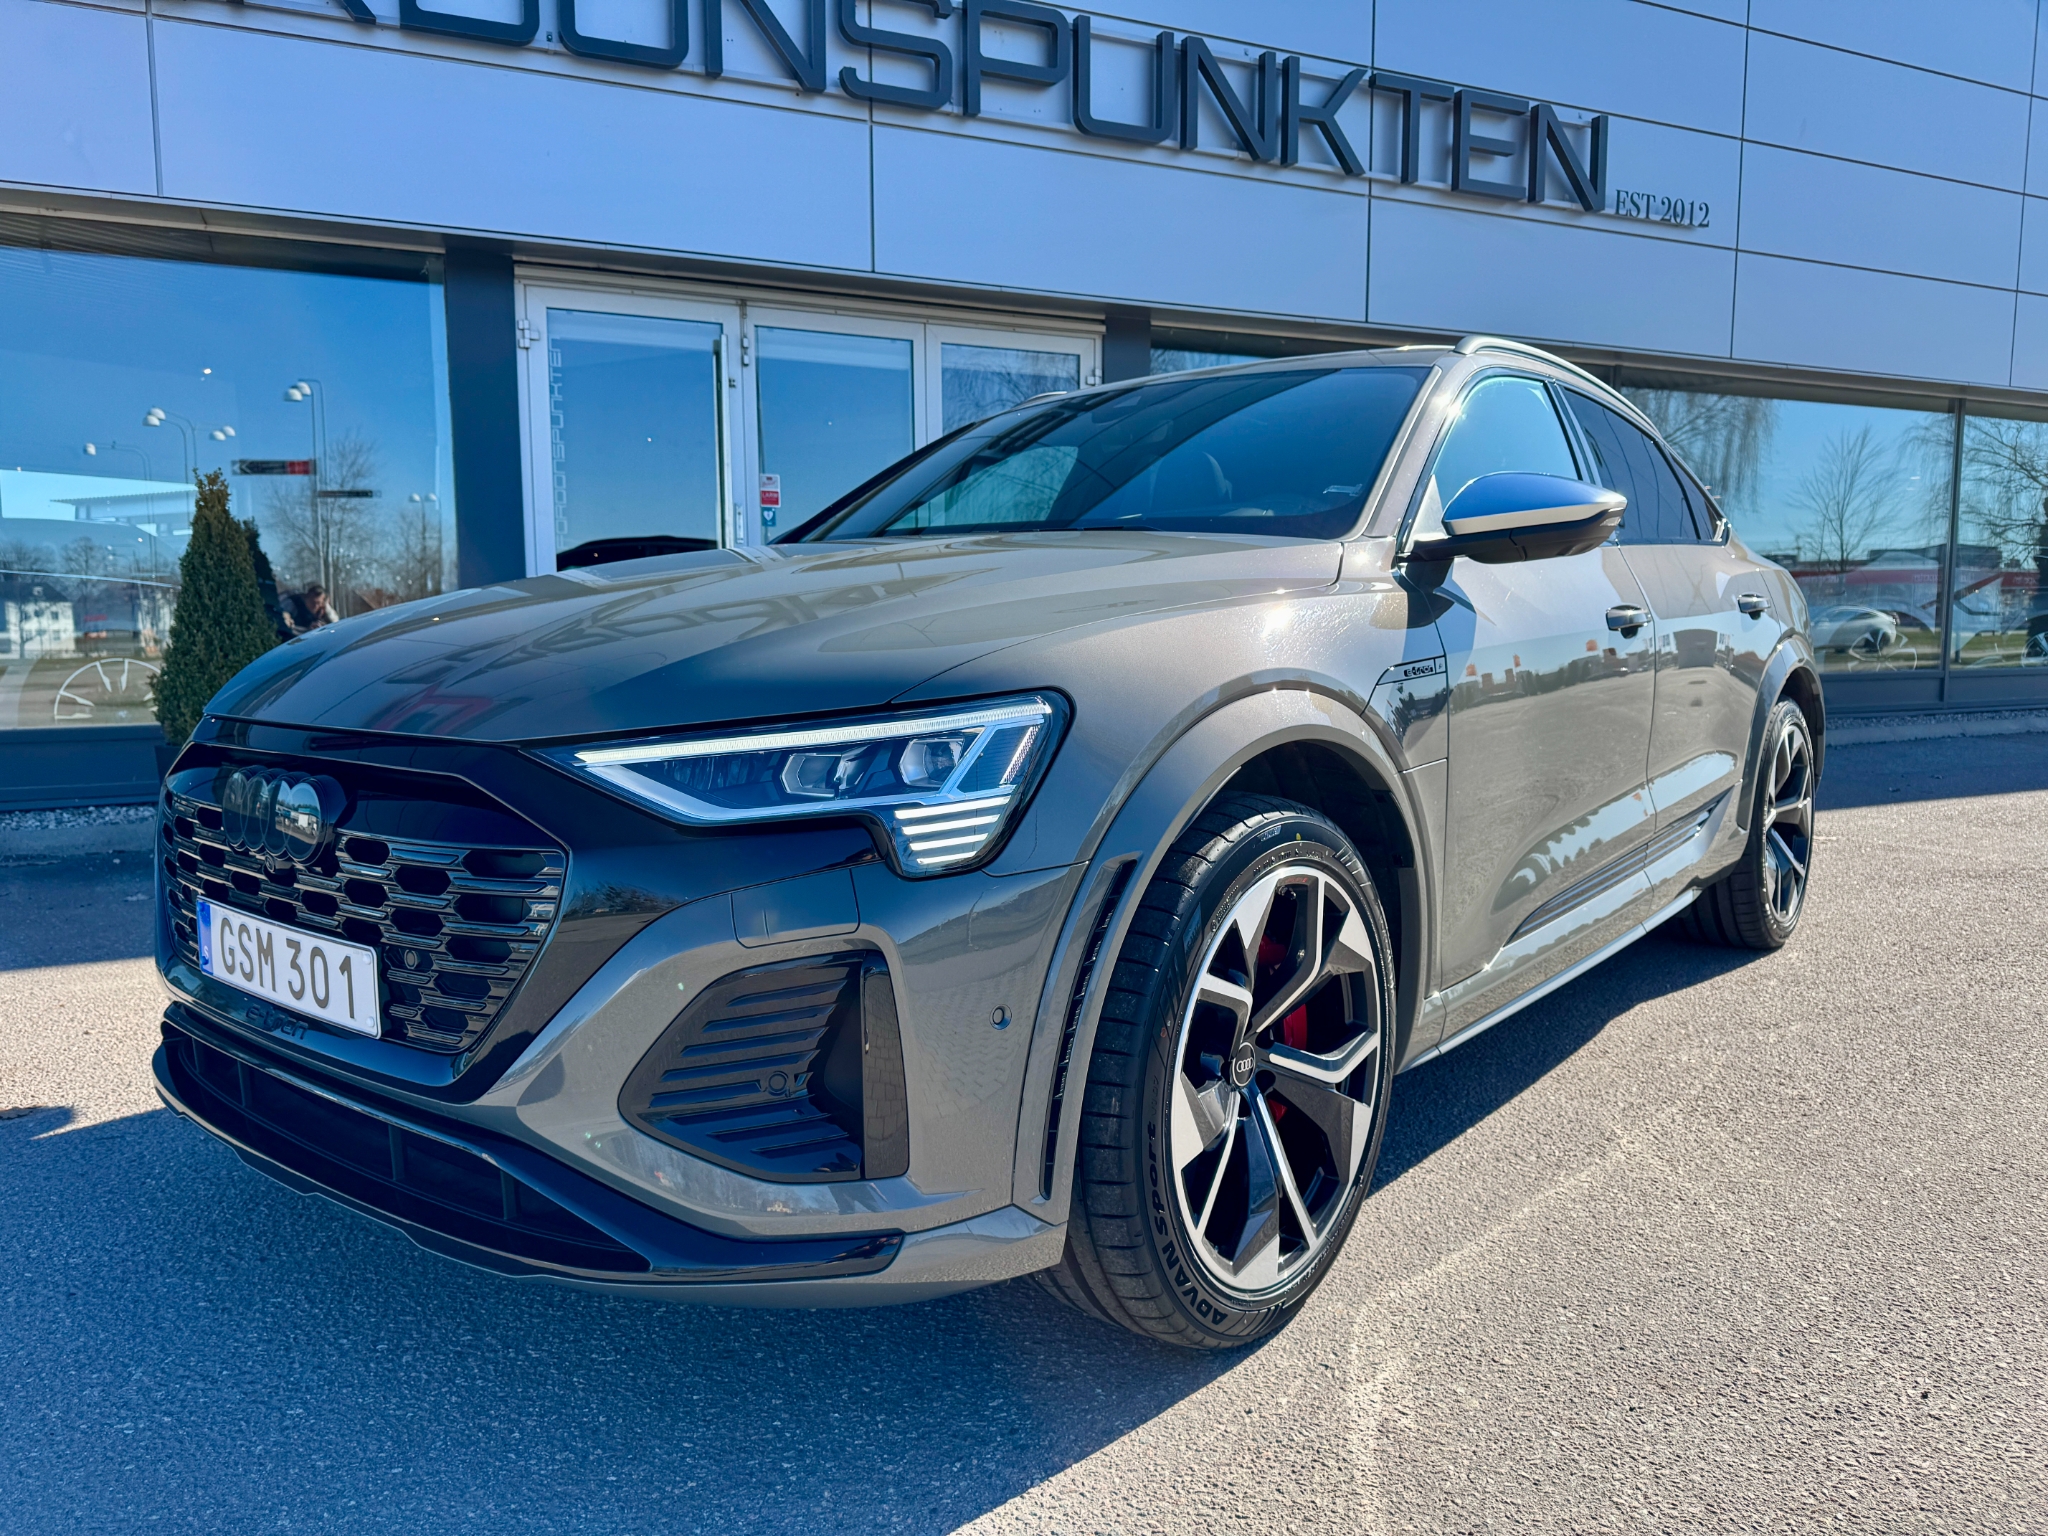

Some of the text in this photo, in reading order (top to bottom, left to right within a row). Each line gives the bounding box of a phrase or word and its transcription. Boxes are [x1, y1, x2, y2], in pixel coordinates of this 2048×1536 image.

[1615, 189, 1710, 228] EST 2012
[203, 945, 210, 960] S
[220, 917, 356, 1020] GSM 301
[1147, 1120, 1169, 1237] Sport
[1161, 1239, 1229, 1326] ADVAN
